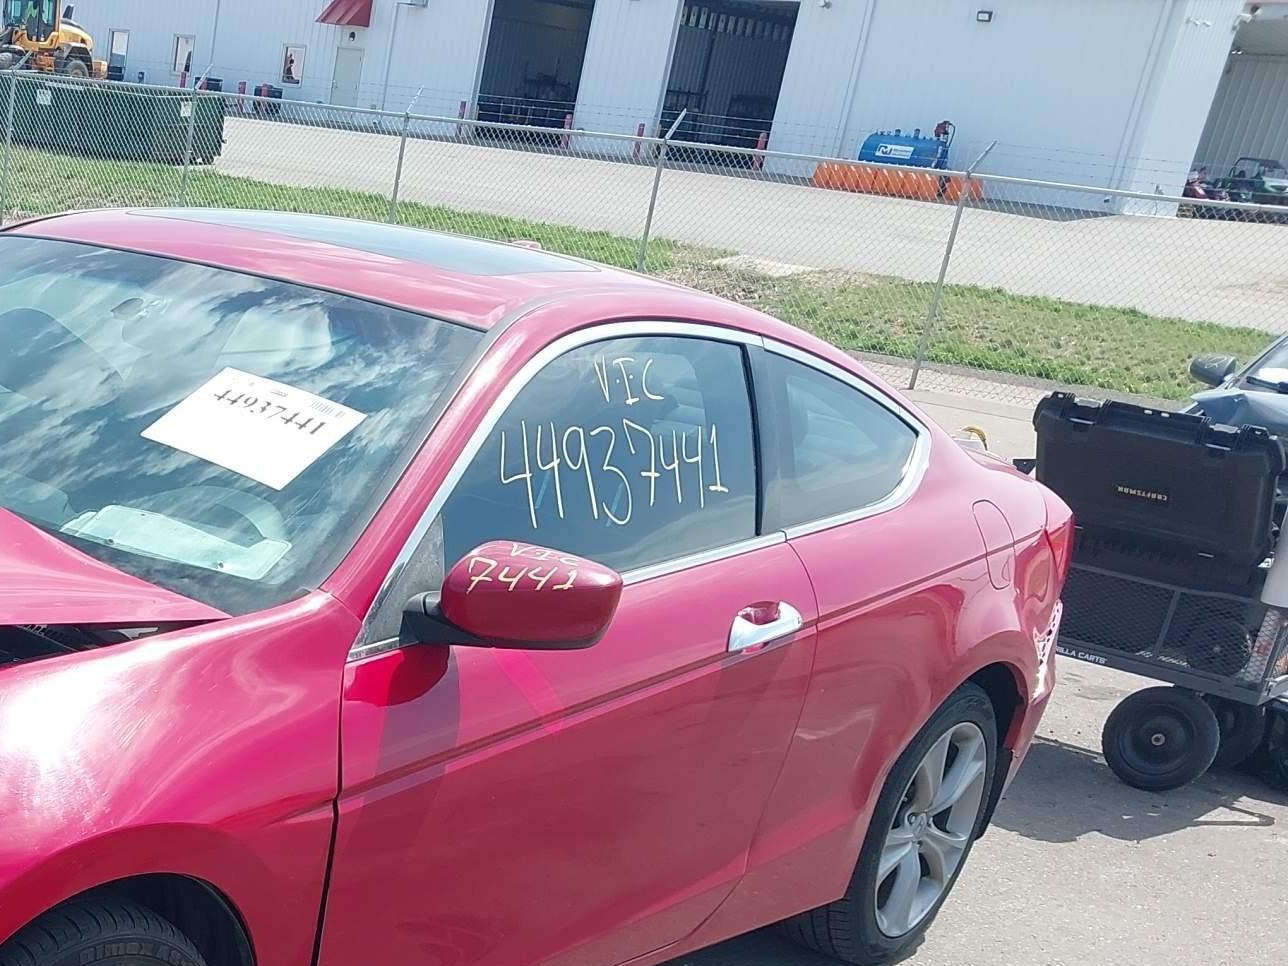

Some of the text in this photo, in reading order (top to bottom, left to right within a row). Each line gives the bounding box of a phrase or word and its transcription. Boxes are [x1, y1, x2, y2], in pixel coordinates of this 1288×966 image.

[214, 389, 327, 435] 44937441
[498, 418, 729, 528] 44937441
[466, 556, 577, 595] 7441
